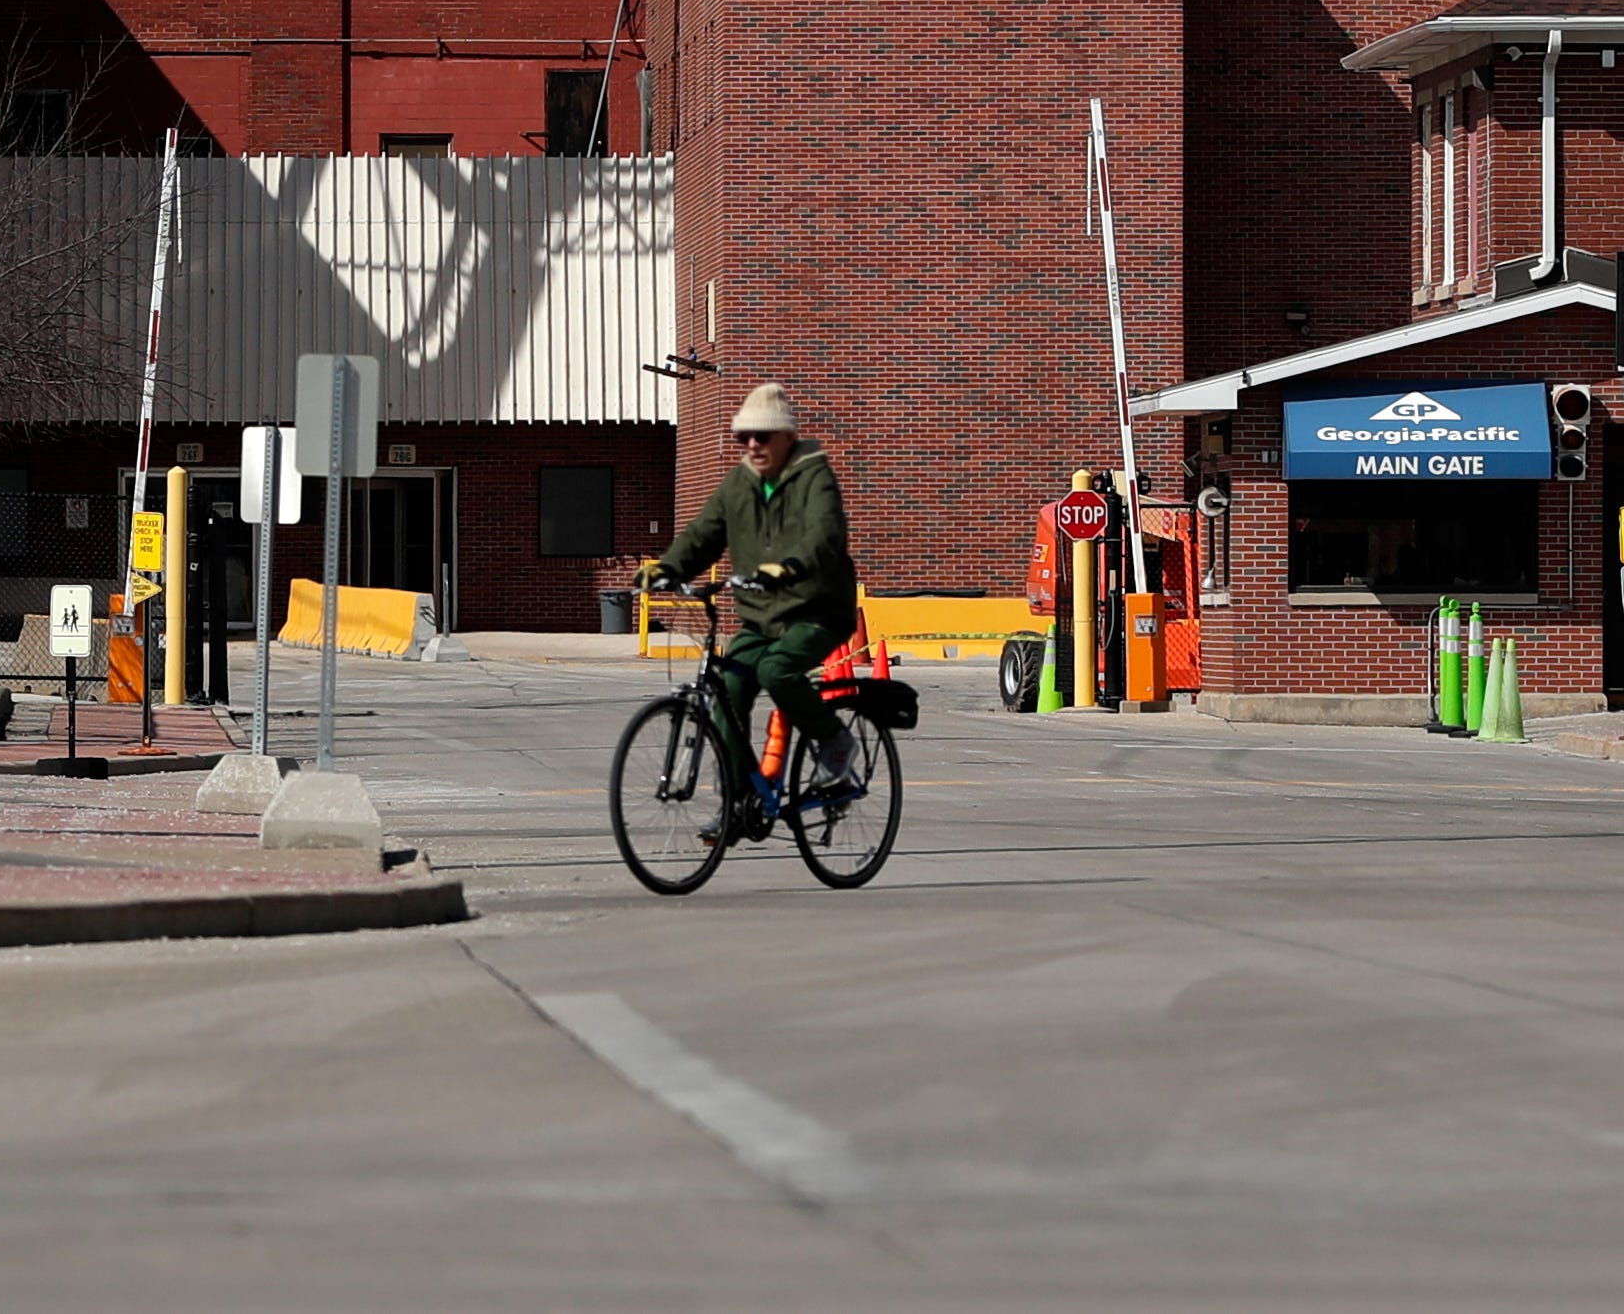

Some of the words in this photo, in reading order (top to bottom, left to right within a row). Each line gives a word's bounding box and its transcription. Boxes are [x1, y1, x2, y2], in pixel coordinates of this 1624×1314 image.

[1391, 404, 1439, 418] GP
[1316, 426, 1520, 445] Georgia-Pacific
[1355, 455, 1419, 476] MAIN
[1428, 455, 1484, 476] GATE
[1061, 505, 1105, 525] STOP
[140, 536, 154, 544] STOP
